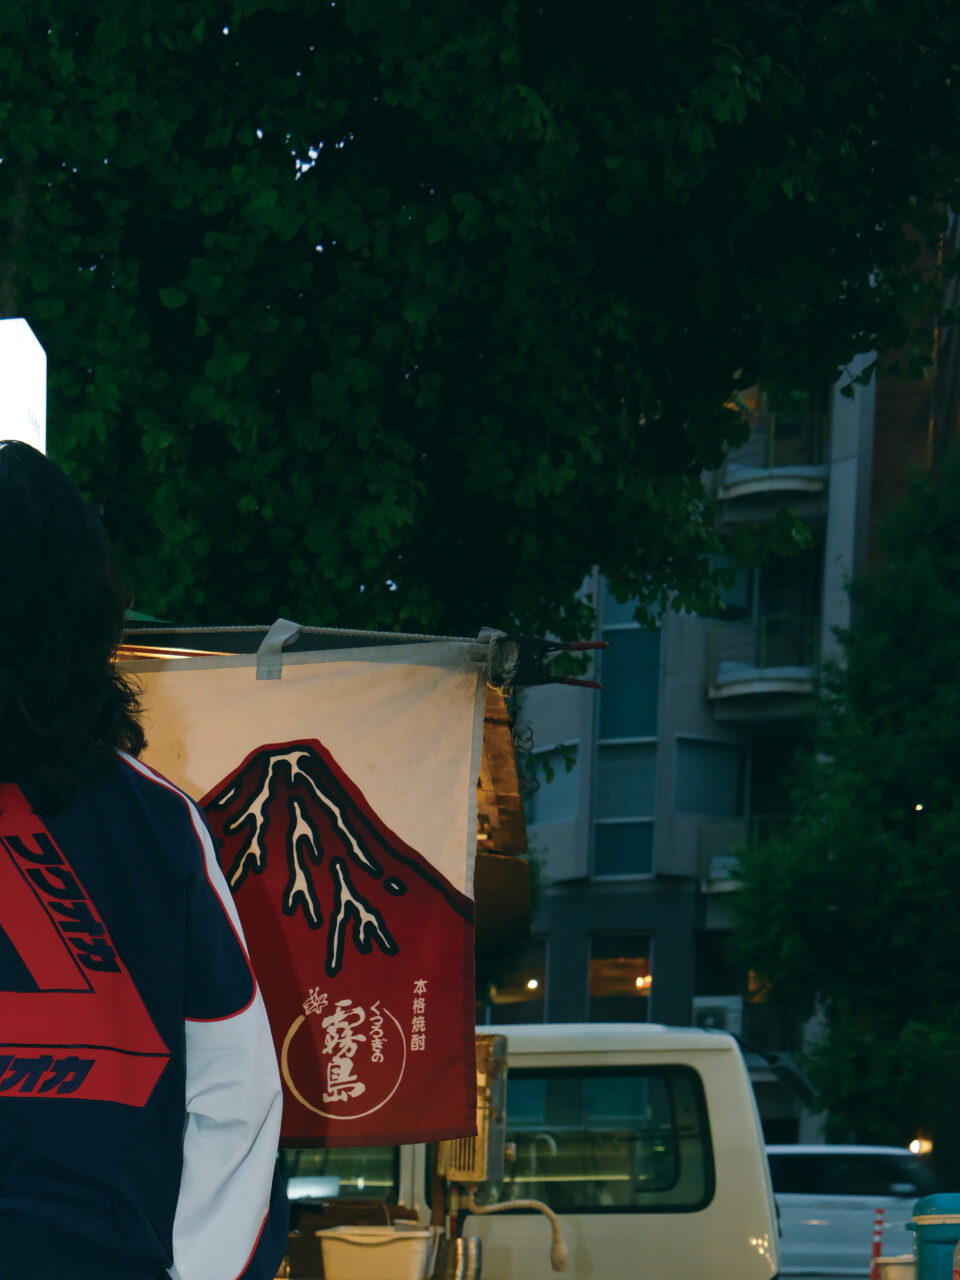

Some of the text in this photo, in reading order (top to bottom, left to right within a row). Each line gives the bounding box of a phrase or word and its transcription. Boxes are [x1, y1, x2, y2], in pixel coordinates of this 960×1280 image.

[321, 999, 367, 1103] 霧島
[368, 1000, 387, 1063] くつろぎの
[410, 979, 428, 1051] 本格焼酎
